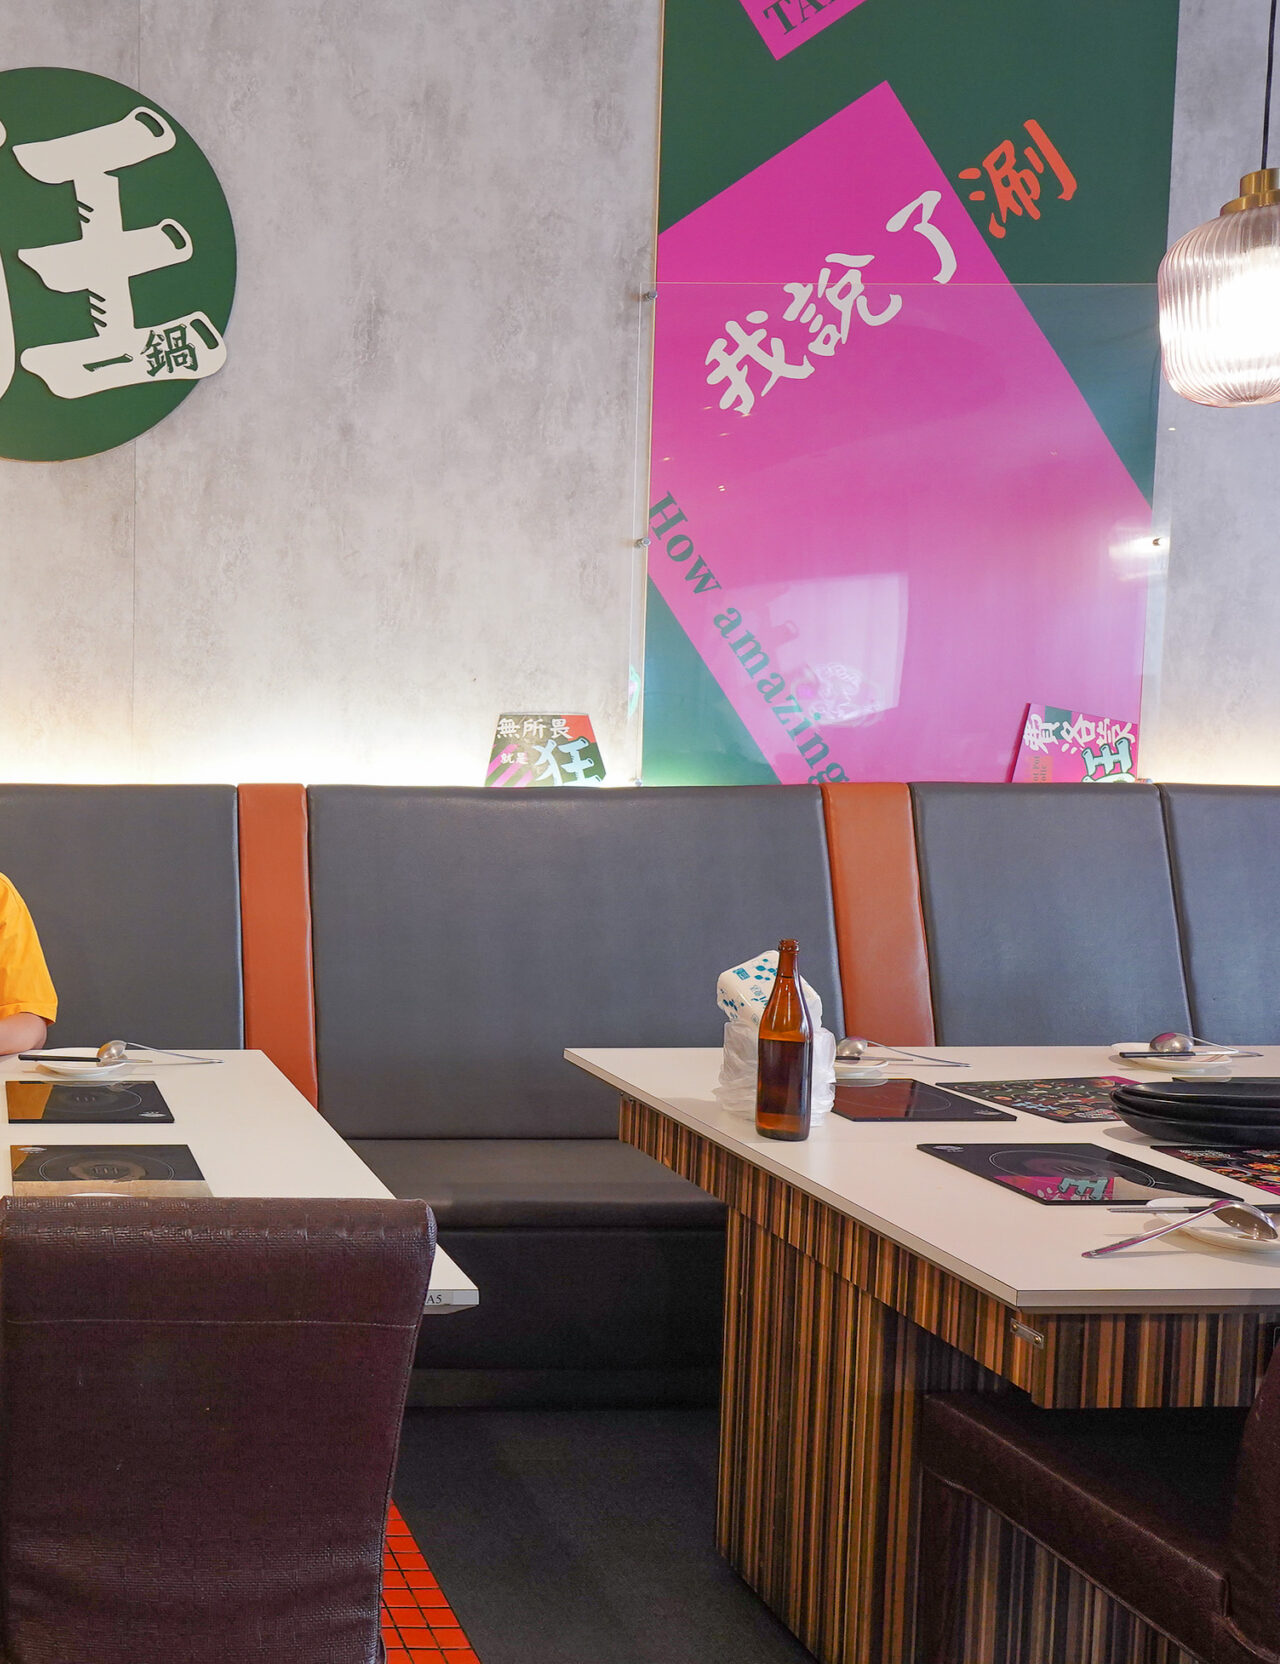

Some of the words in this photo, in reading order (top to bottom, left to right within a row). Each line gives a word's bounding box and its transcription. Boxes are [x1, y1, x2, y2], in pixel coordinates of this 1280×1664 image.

[762, 0, 836, 35] TA
[649, 490, 722, 595] How
[713, 607, 850, 784] amazing
[496, 718, 574, 739] 無所畏
